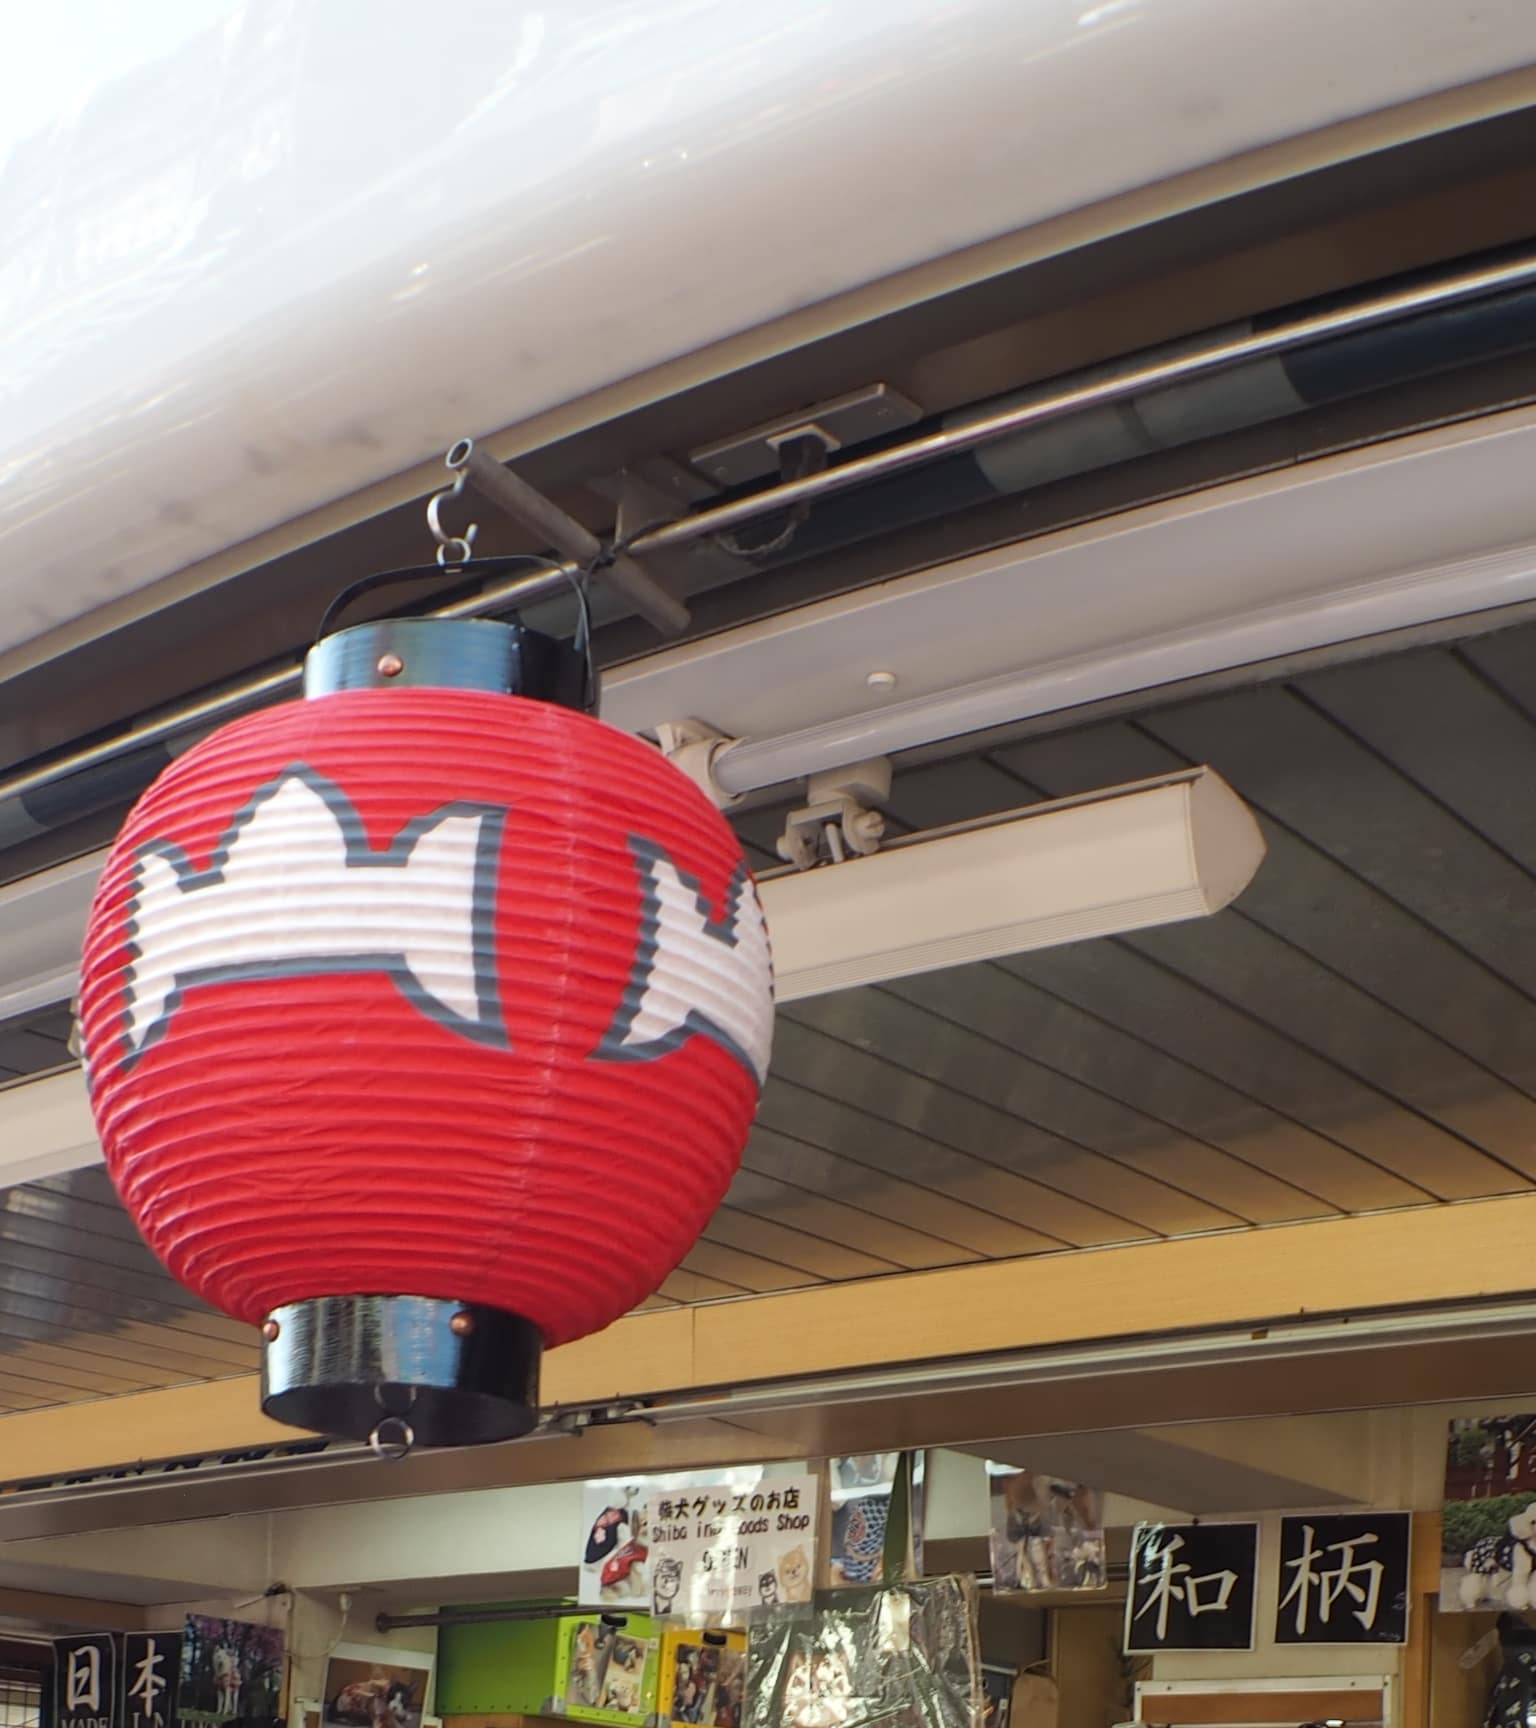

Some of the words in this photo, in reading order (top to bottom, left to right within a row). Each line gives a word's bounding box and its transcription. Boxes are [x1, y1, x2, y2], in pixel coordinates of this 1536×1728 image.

[658, 1487, 800, 1521] 柴犬グッズのお店
[652, 1524, 687, 1544] Shiba
[732, 1518, 769, 1536] oods
[777, 1513, 810, 1532] Shop
